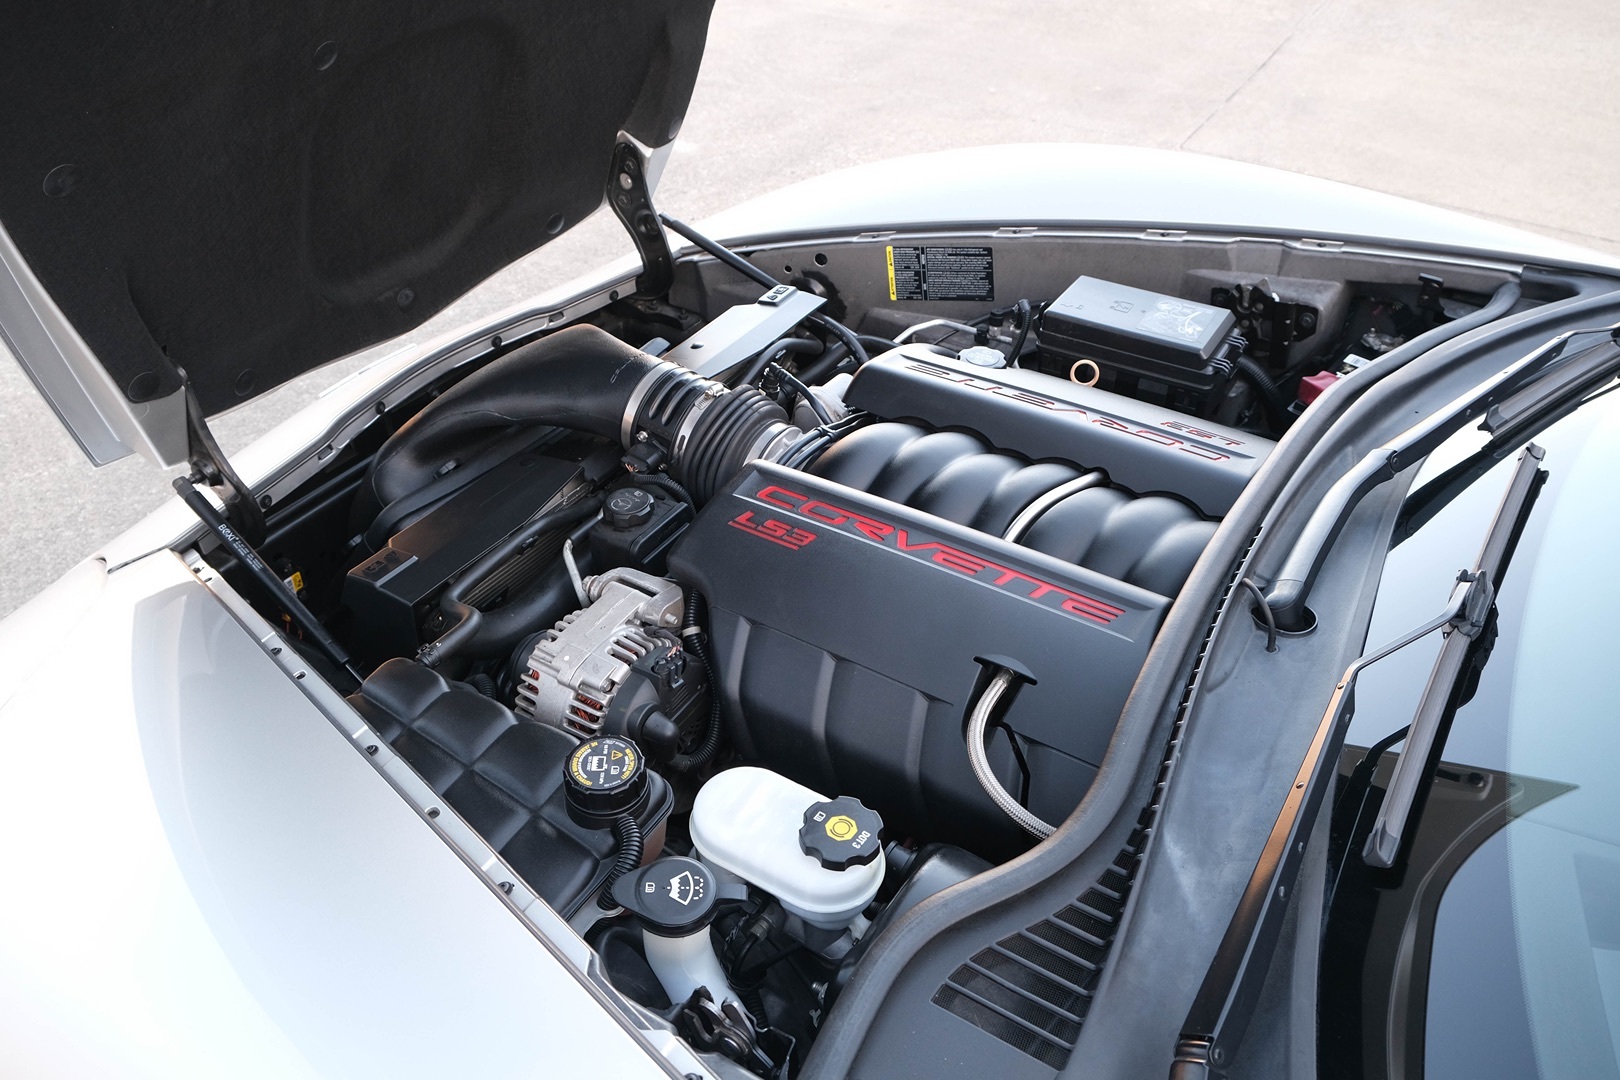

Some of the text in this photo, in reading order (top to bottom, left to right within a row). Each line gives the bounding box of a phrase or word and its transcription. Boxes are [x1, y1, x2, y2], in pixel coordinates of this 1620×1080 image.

[904, 363, 1231, 462] CORVETTE
[728, 510, 819, 550] LS3
[755, 485, 1126, 625] CORVETTE
[856, 830, 871, 845] DOT
